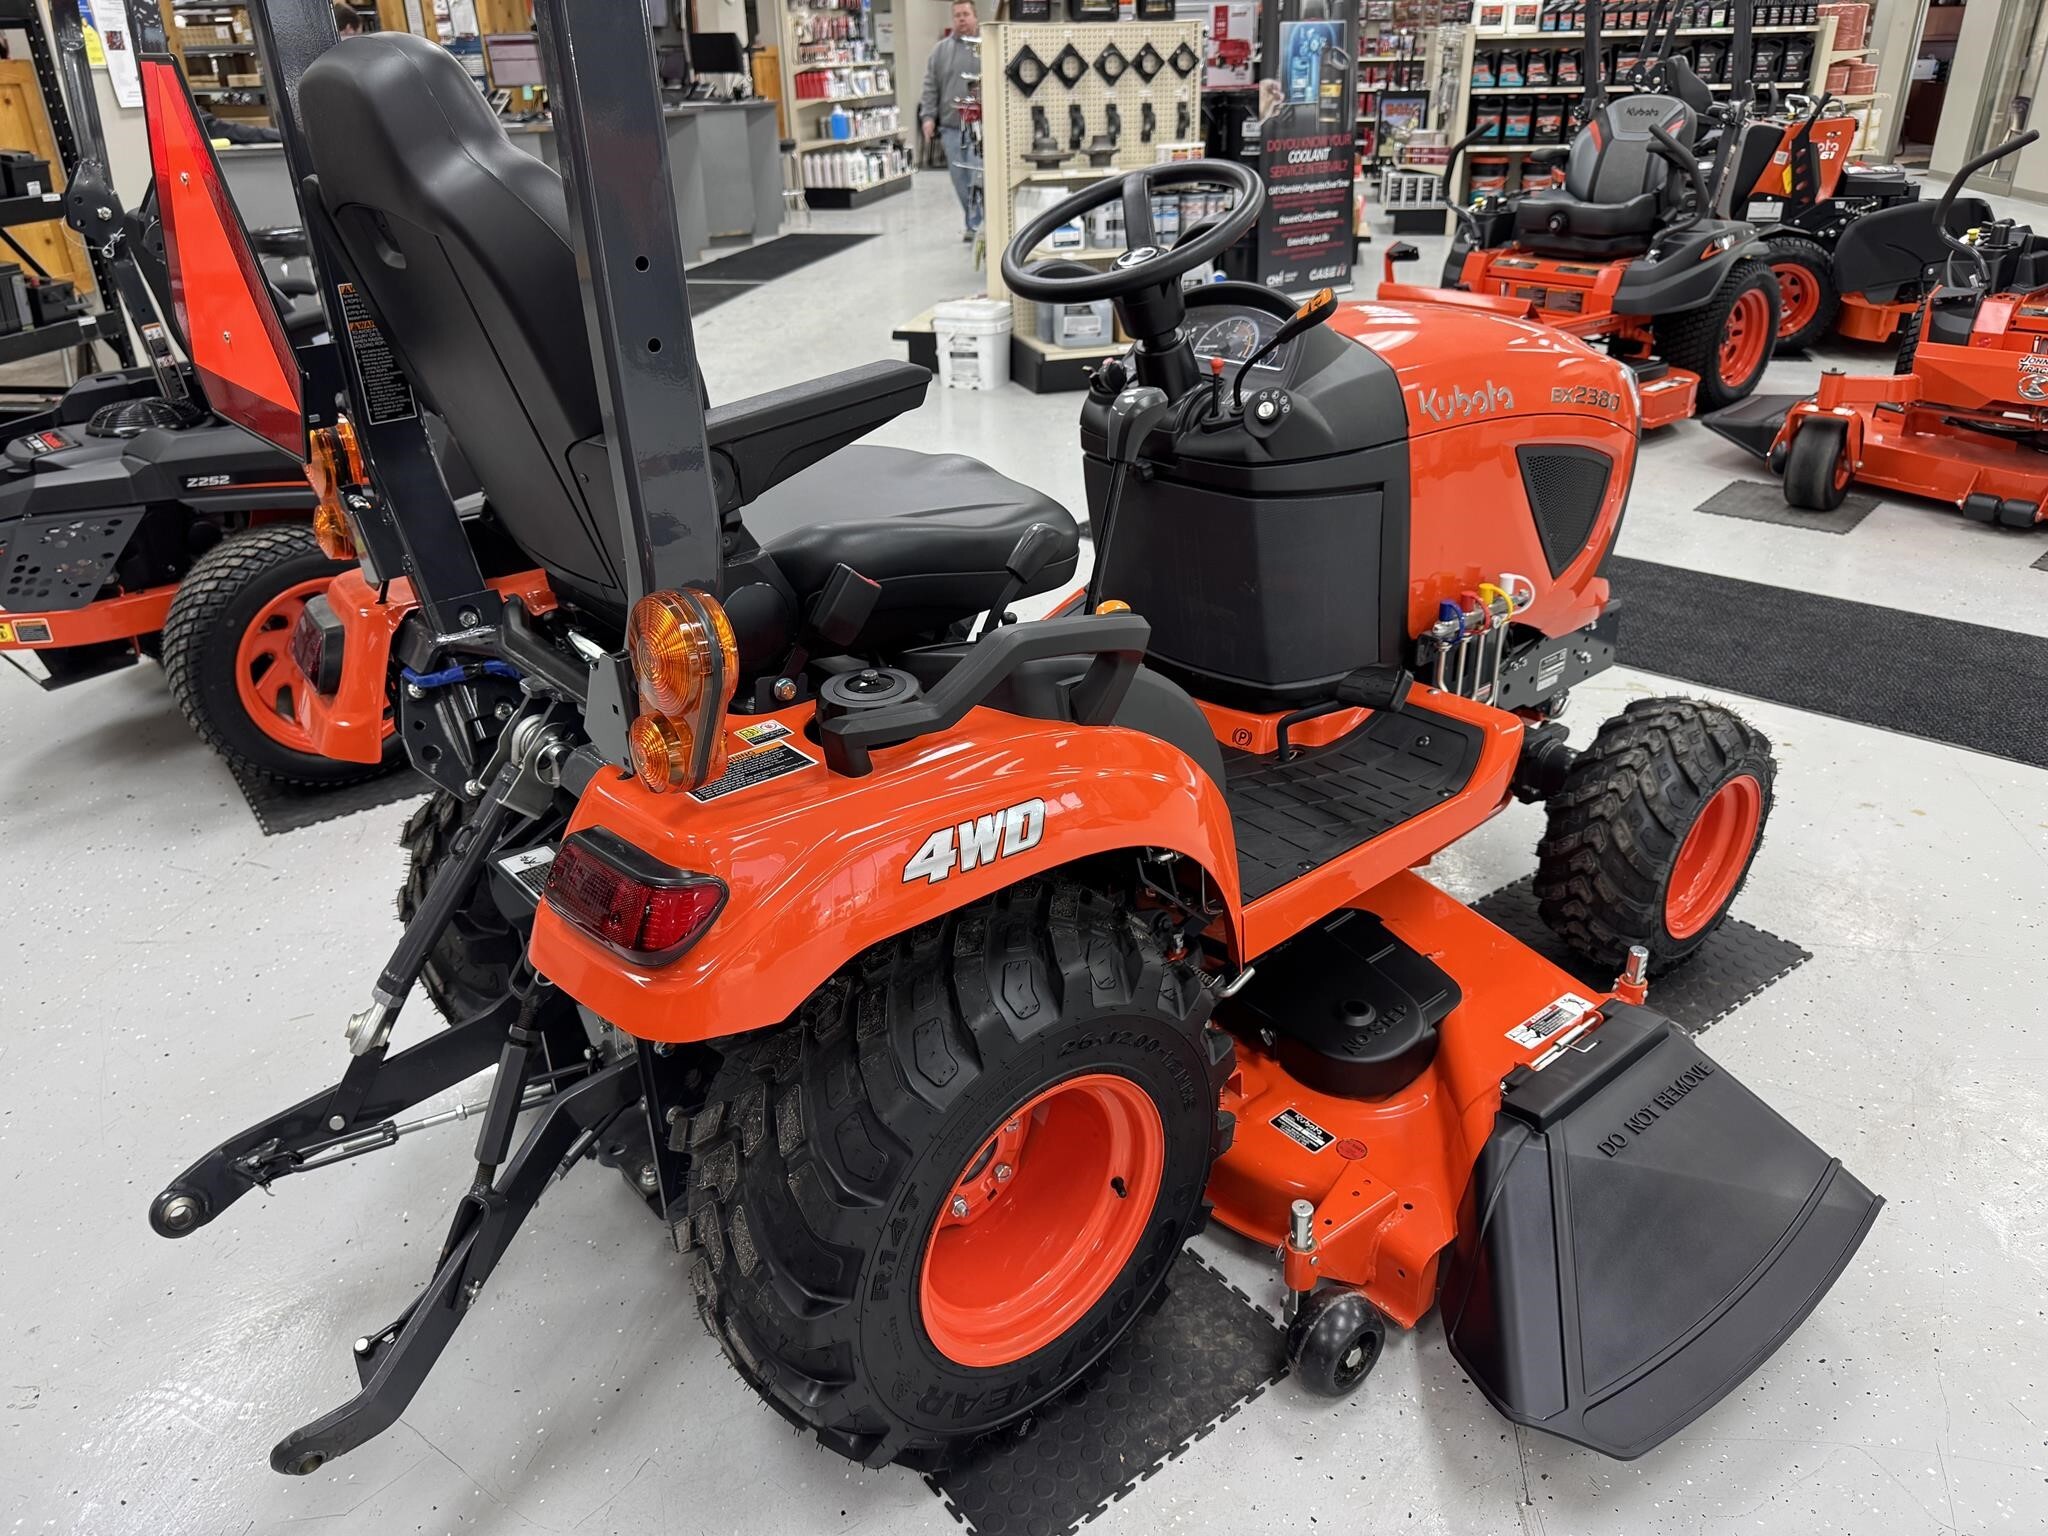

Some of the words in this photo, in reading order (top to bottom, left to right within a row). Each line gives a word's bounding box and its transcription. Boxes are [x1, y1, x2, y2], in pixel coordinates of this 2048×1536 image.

[1626, 107, 1659, 117] Kubota
[1287, 147, 1331, 164] COOLANT
[1817, 139, 1840, 151] ota
[1269, 165, 1305, 178] SERVICE
[1417, 380, 1514, 422] Kubota
[1551, 385, 1620, 412] BX2380
[187, 475, 230, 488] Z252
[902, 797, 1045, 885] 4WD
[1342, 1034, 1370, 1055] NO
[1366, 1004, 1408, 1036] STEP
[1596, 1132, 1628, 1157] DO
[1624, 1104, 1660, 1135] NOT
[1653, 1061, 1716, 1110] REMOVE
[1294, 1113, 1323, 1135] Kubota
